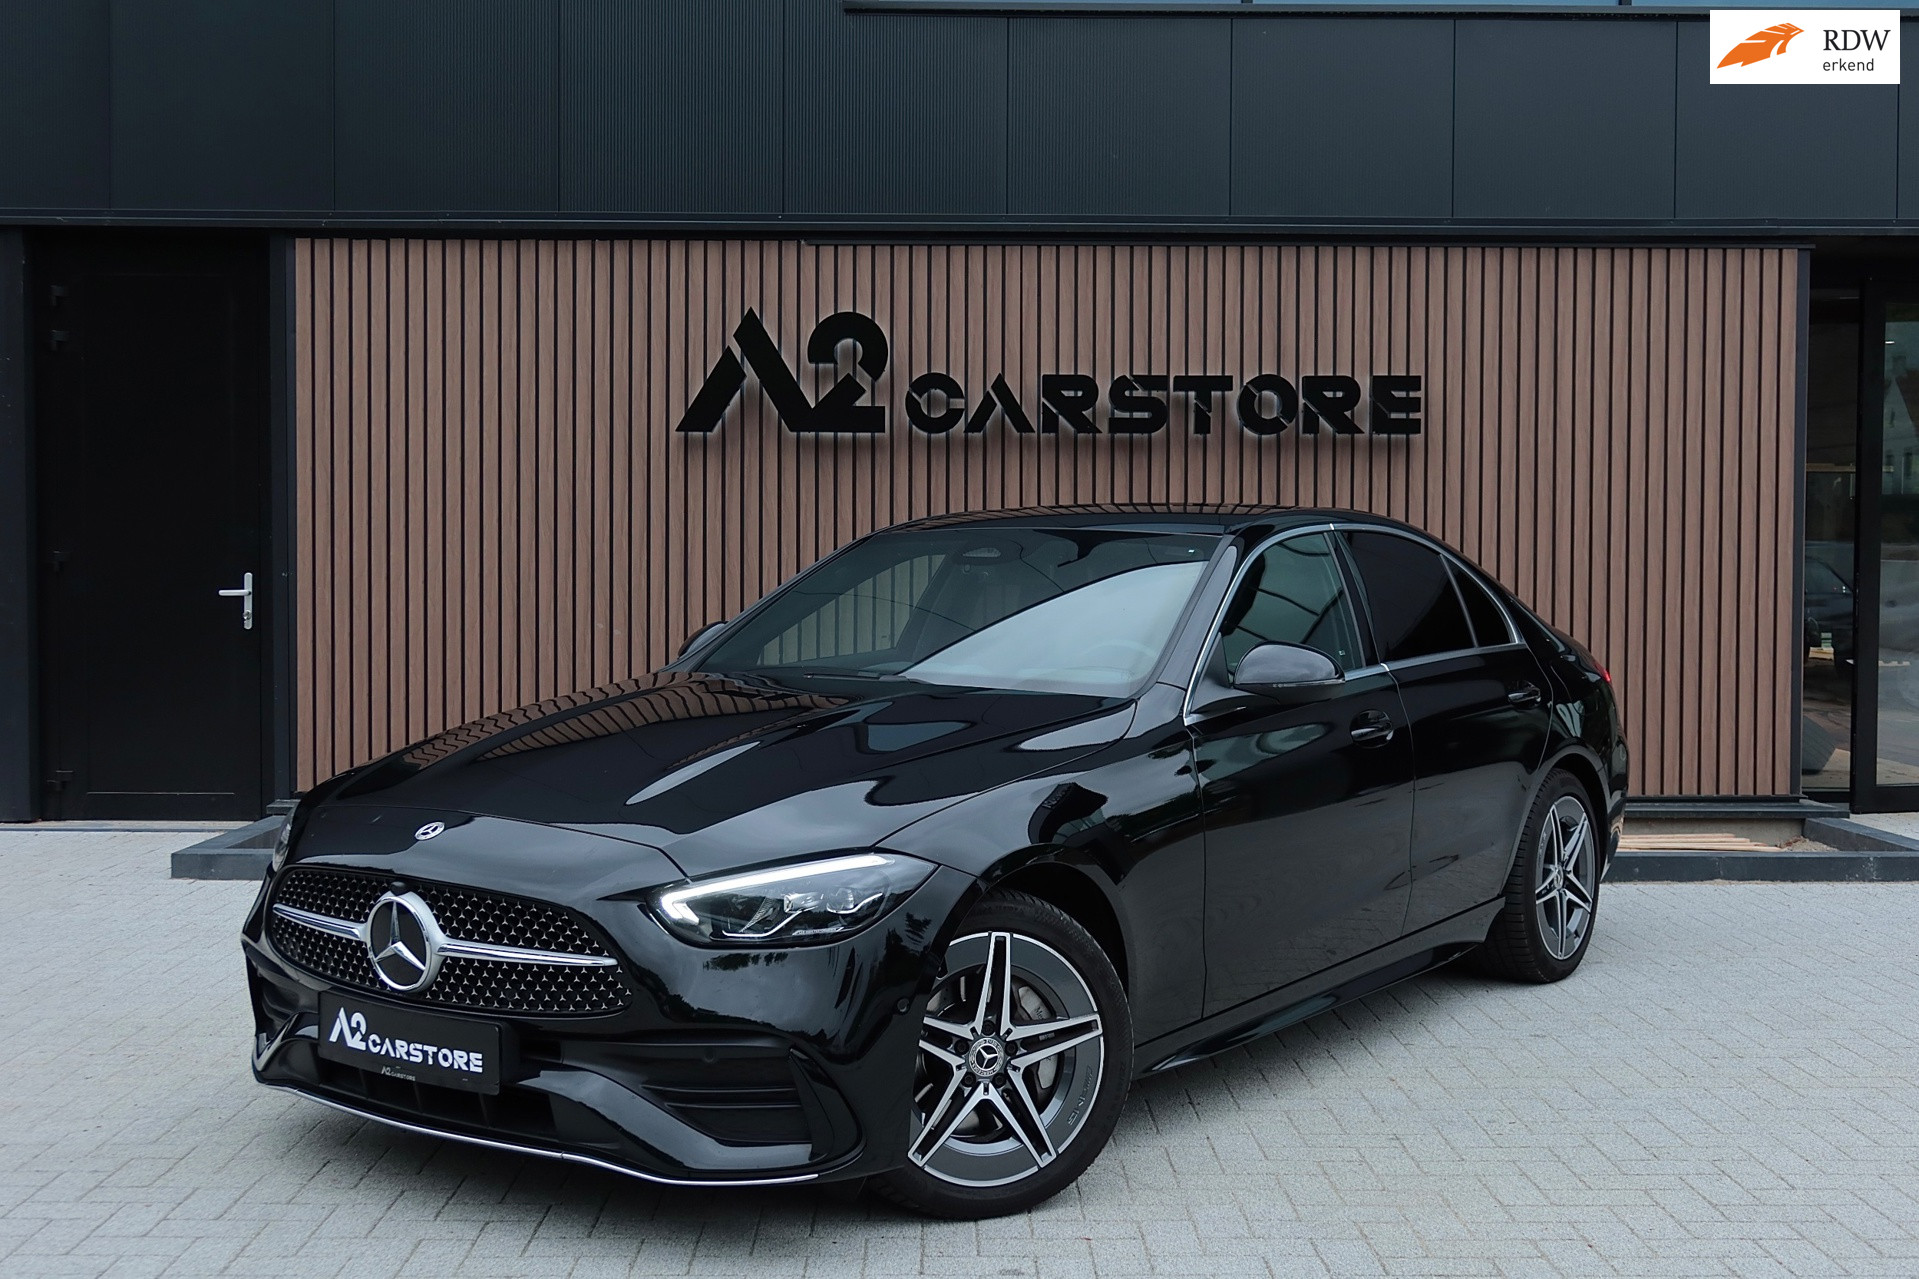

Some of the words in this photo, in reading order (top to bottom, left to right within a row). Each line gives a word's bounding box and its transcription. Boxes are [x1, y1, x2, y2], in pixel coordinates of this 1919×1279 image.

[675, 306, 888, 433] A2
[905, 372, 1421, 436] CARSTORE
[329, 1007, 366, 1051] A2
[367, 1034, 483, 1073] CARSTORE
